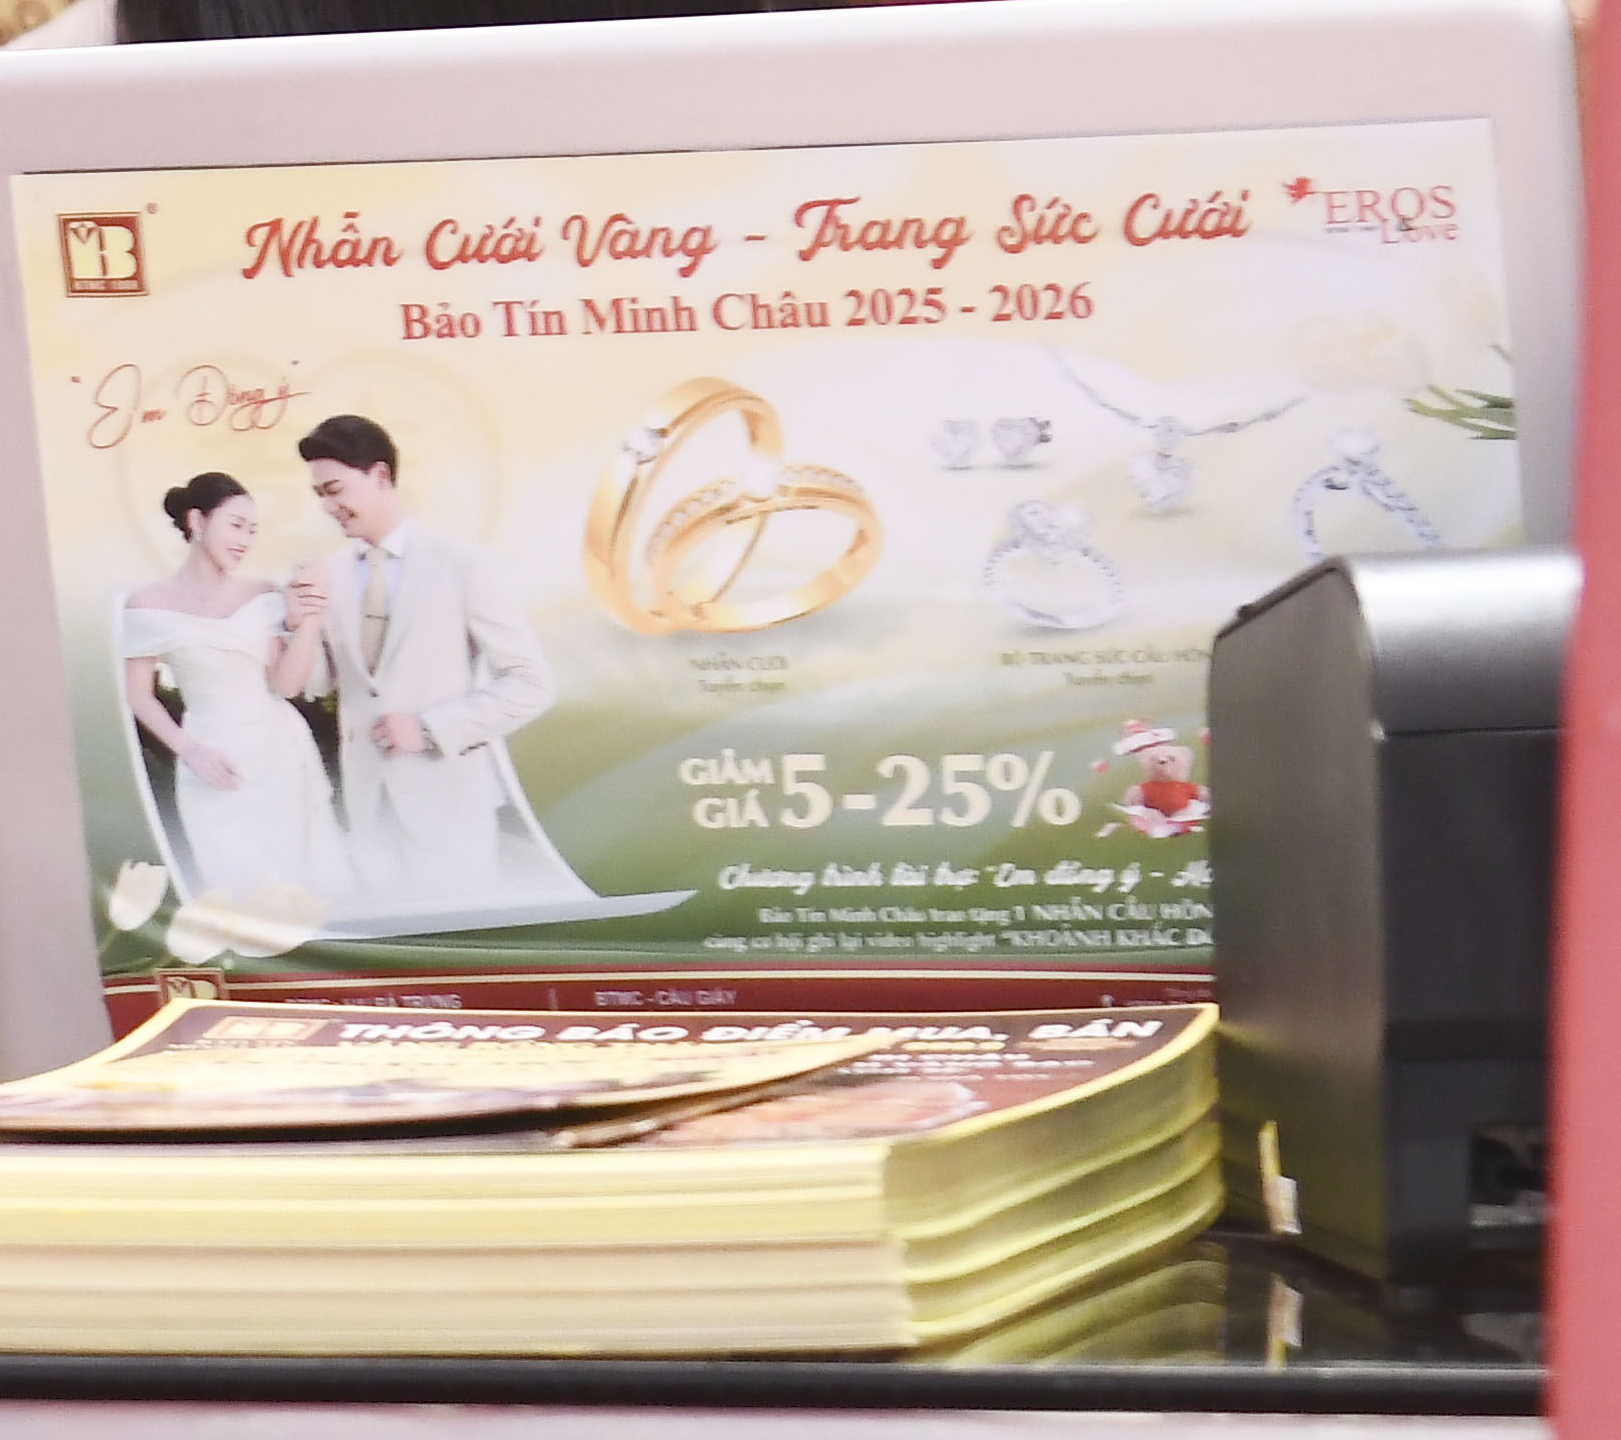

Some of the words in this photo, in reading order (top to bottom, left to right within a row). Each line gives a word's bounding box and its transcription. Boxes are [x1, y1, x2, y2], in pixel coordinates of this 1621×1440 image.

[242, 211, 401, 279] Nhẫn
[561, 213, 717, 278] Vàng
[996, 192, 1100, 255] Sức
[401, 301, 481, 340] Bảo
[492, 299, 568, 336] Tín
[582, 294, 698, 334] Minh
[713, 290, 831, 330] Châu
[845, 287, 946, 327] 2025
[990, 281, 1093, 322] 2026
[680, 749, 774, 786] GIẢM
[692, 790, 769, 828] GIÁ
